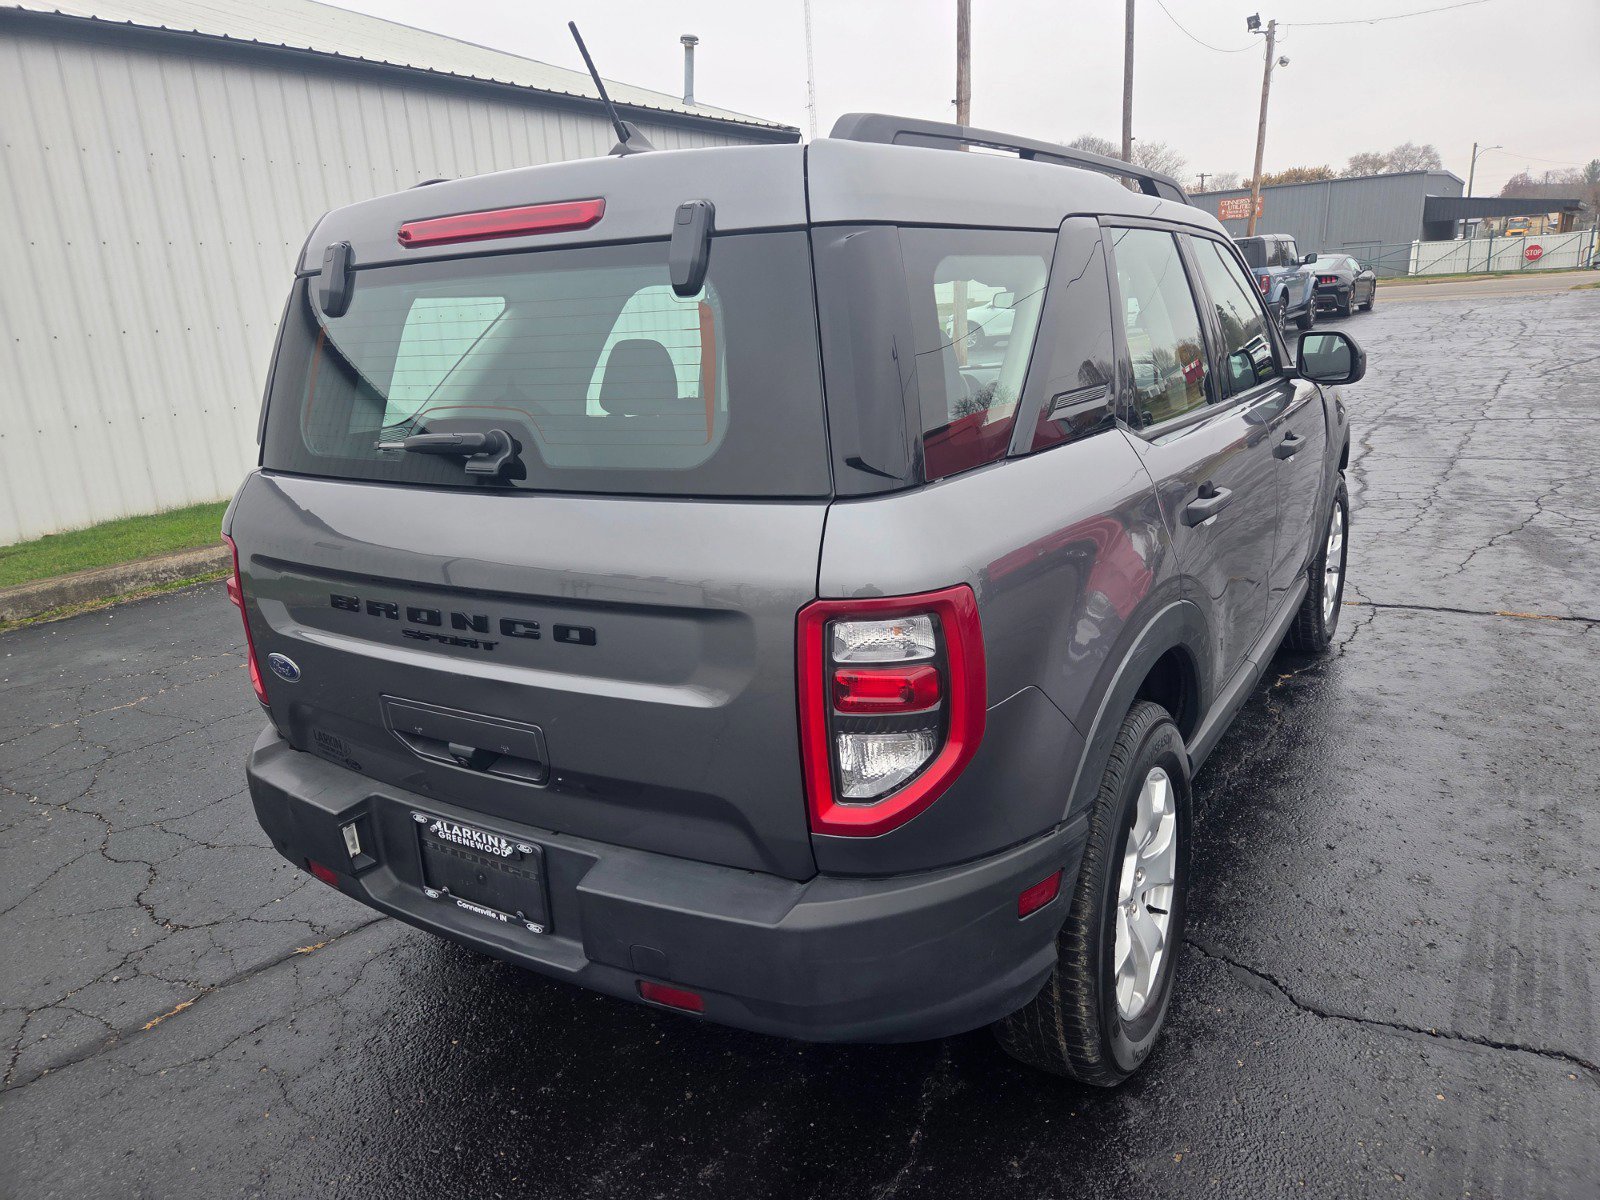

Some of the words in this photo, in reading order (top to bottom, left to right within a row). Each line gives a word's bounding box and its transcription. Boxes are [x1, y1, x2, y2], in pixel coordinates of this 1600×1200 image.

[1525, 249, 1542, 257] STOP
[330, 594, 596, 646] BRONCO
[402, 628, 499, 651] SPORT
[438, 831, 509, 857] GREENEWOOD
[443, 822, 499, 847] LARKIN
[500, 914, 507, 922] IN
